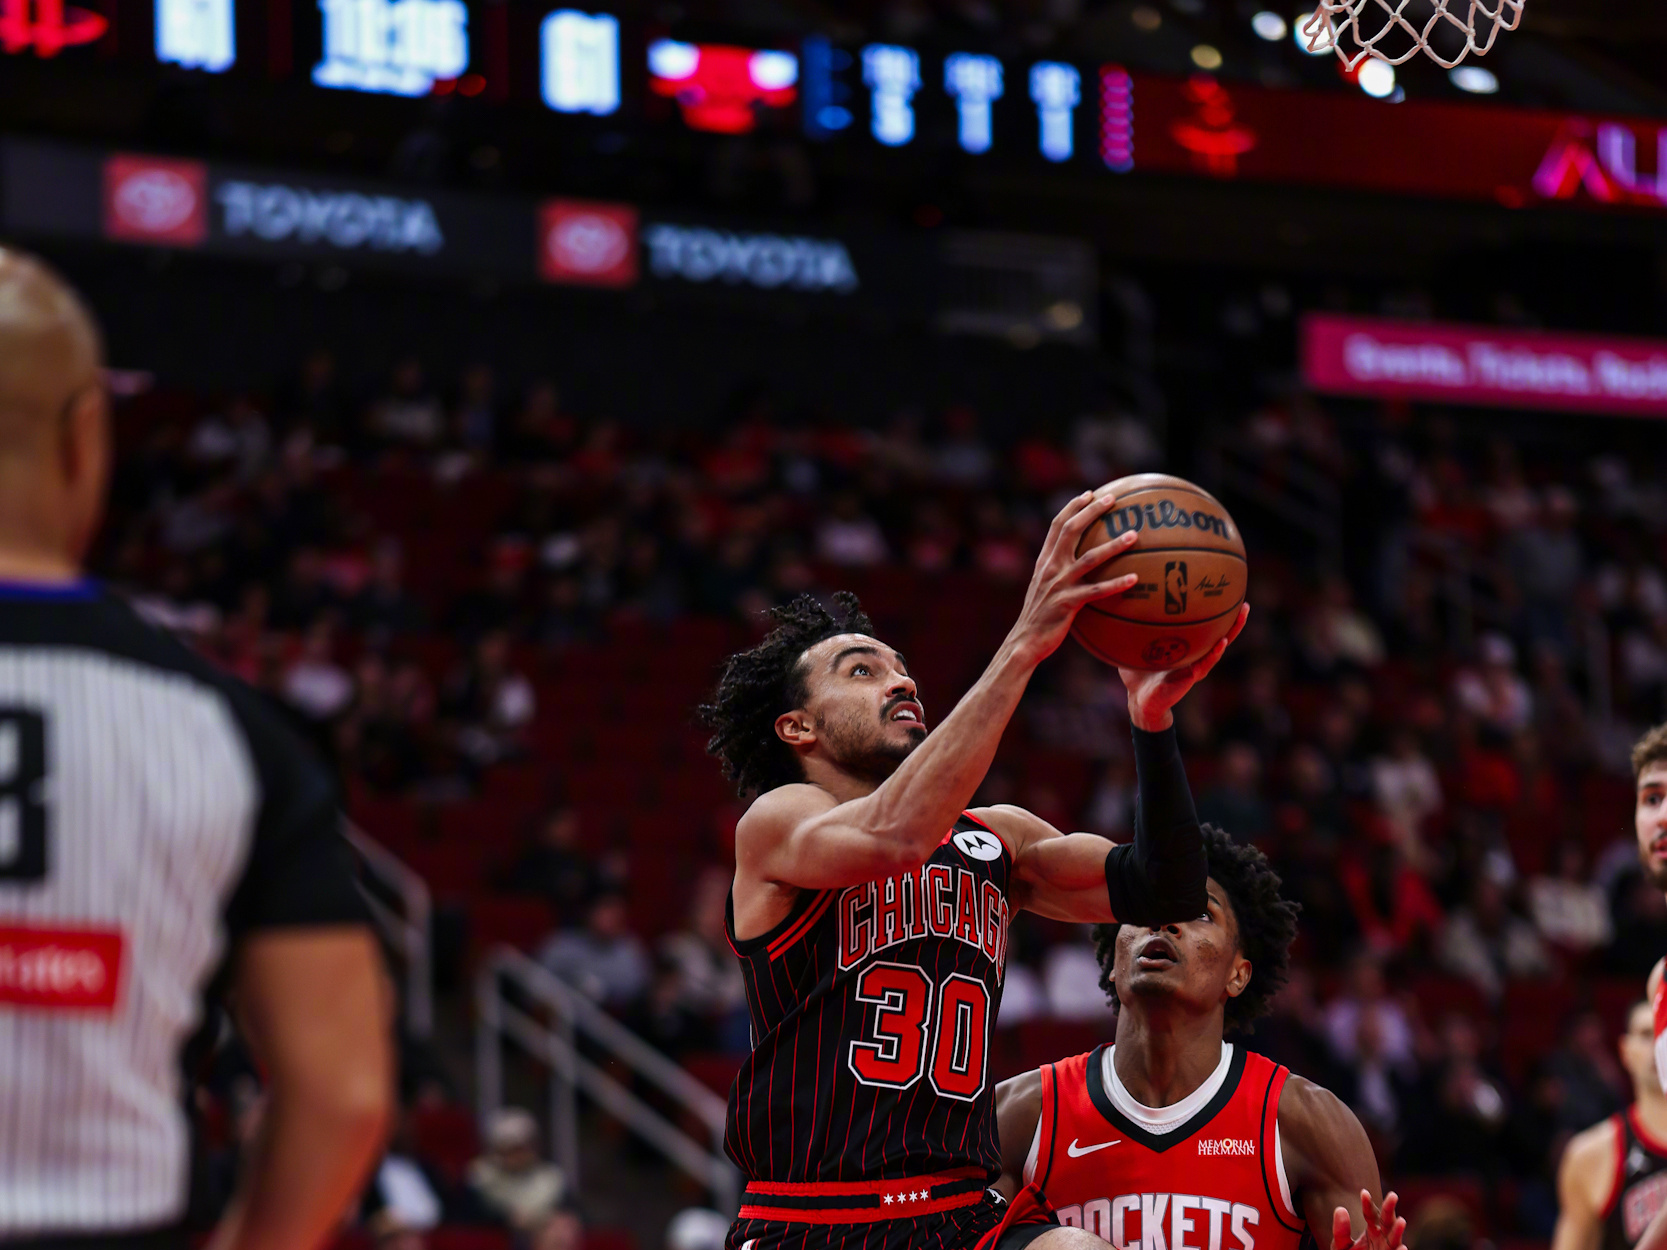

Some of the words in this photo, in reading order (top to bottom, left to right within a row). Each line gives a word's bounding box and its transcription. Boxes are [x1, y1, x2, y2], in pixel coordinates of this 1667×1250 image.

[217, 180, 442, 252] TOYOTA
[647, 224, 856, 288] TOYOTA
[1102, 500, 1230, 541] Wilson
[838, 863, 1009, 988] CHICAGO
[848, 960, 990, 1102] 30
[1198, 1138, 1255, 1149] MEMORIAL
[1198, 1146, 1255, 1155] HERMANN
